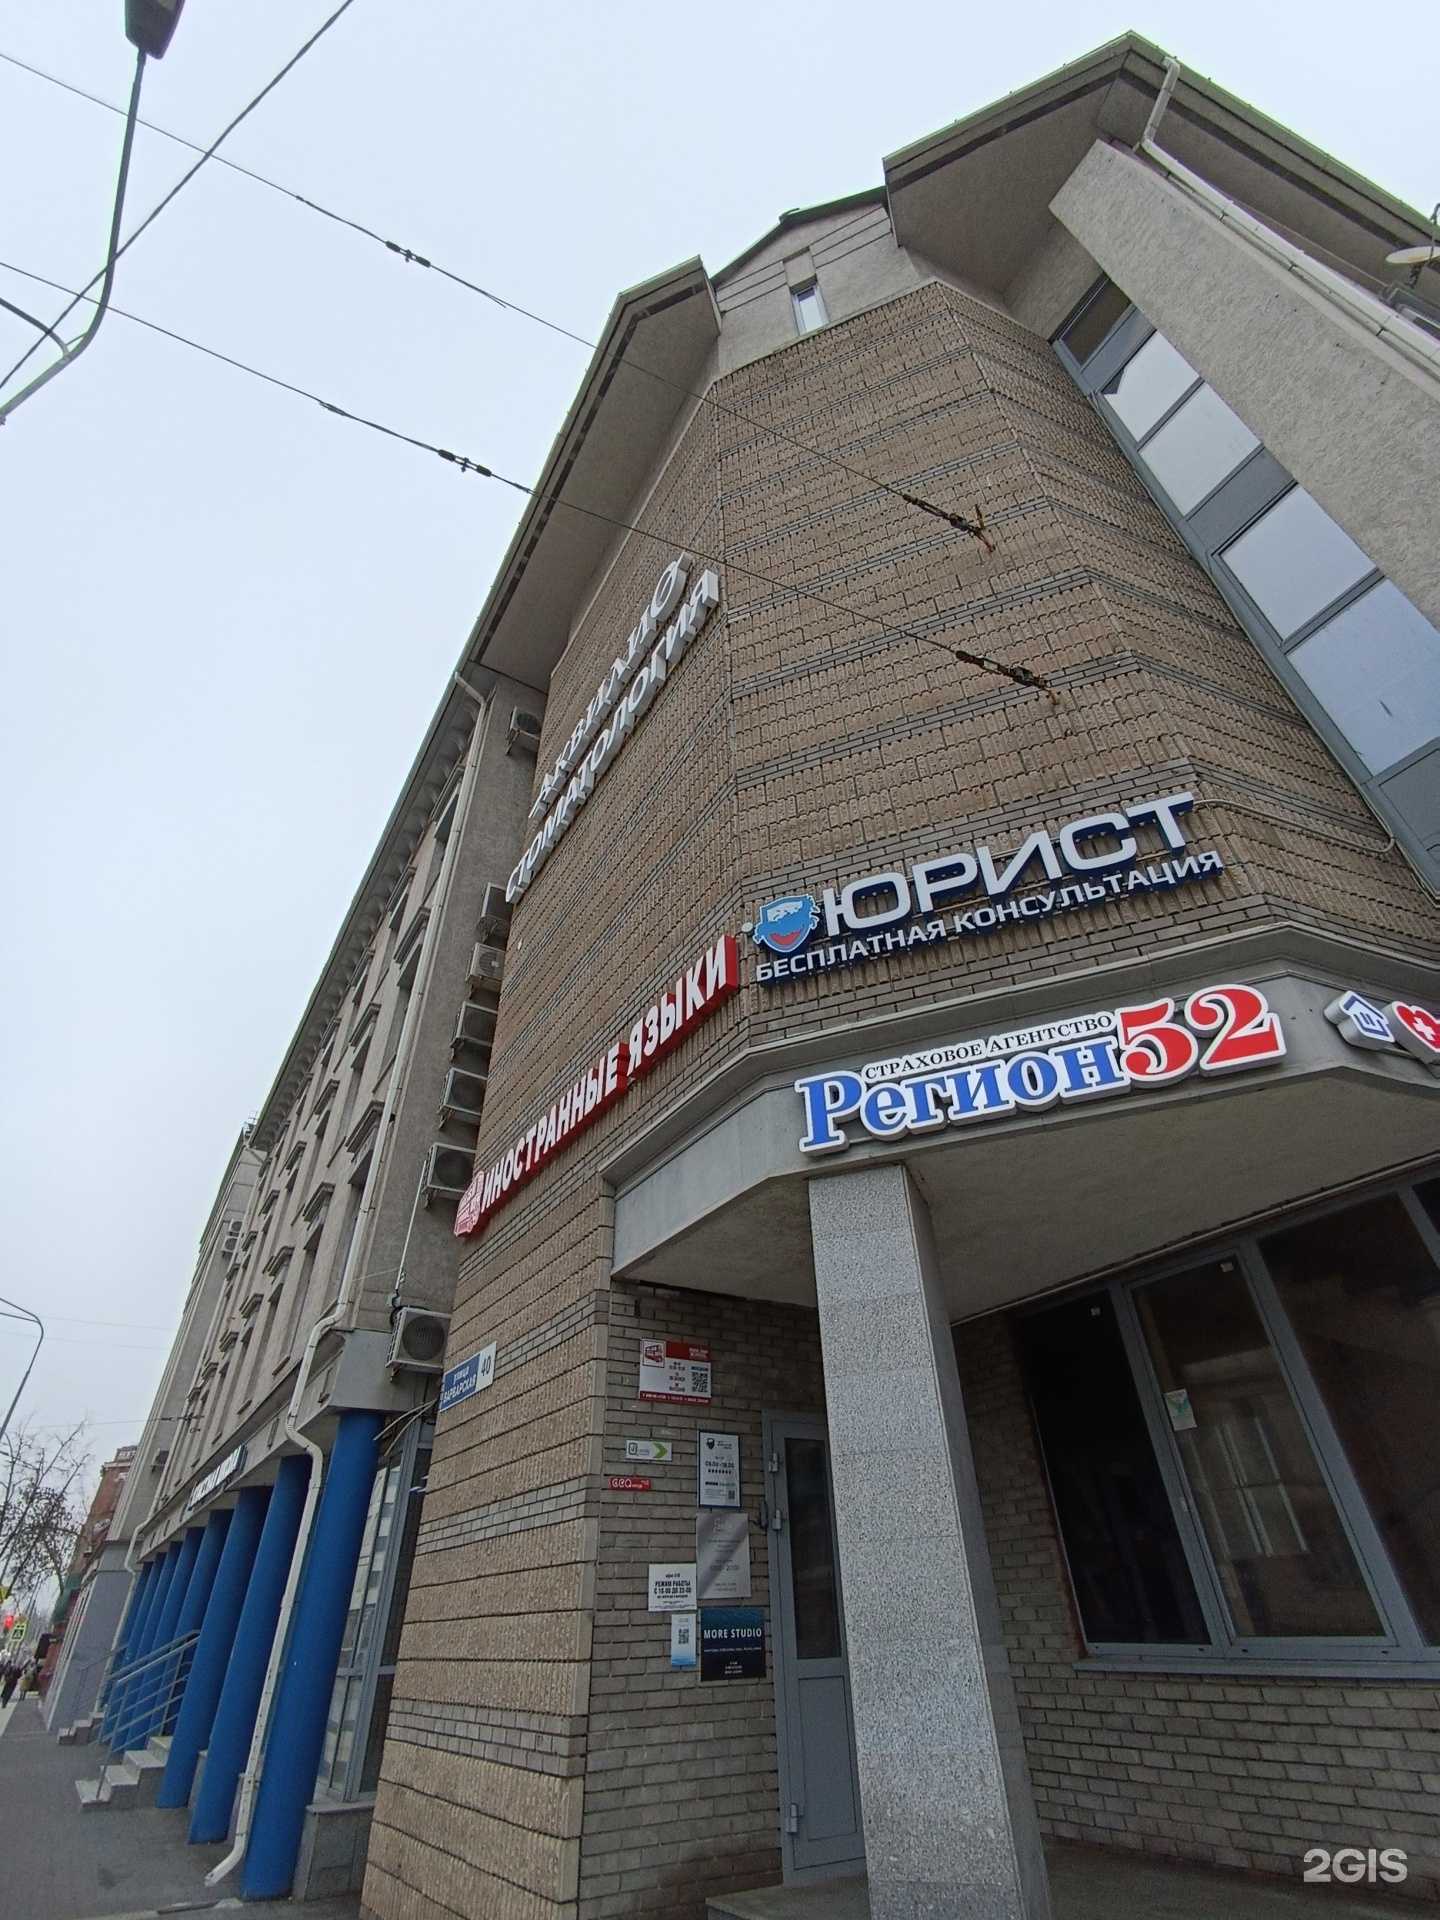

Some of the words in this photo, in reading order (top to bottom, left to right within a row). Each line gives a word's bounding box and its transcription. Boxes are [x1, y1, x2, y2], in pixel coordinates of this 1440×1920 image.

[506, 569, 720, 904] СТОМАТОЛОГИЯ
[756, 920, 947, 983] БЕСПЛАТНАЯ
[953, 850, 1223, 934] КОНСУЛЬТАЦИЯ
[823, 791, 1196, 938] ЮРИСТ
[480, 1041, 622, 1213] ИНОСТРАННЫЕ
[627, 934, 728, 1077] ЯЗЫКИ
[865, 1039, 984, 1081] СТРАХОВОЕ
[985, 1011, 1112, 1055] АГЕНТСТВО
[480, 1354, 492, 1377] 40
[703, 1629, 728, 1639] MORE
[730, 1628, 762, 1639] STUDIO
